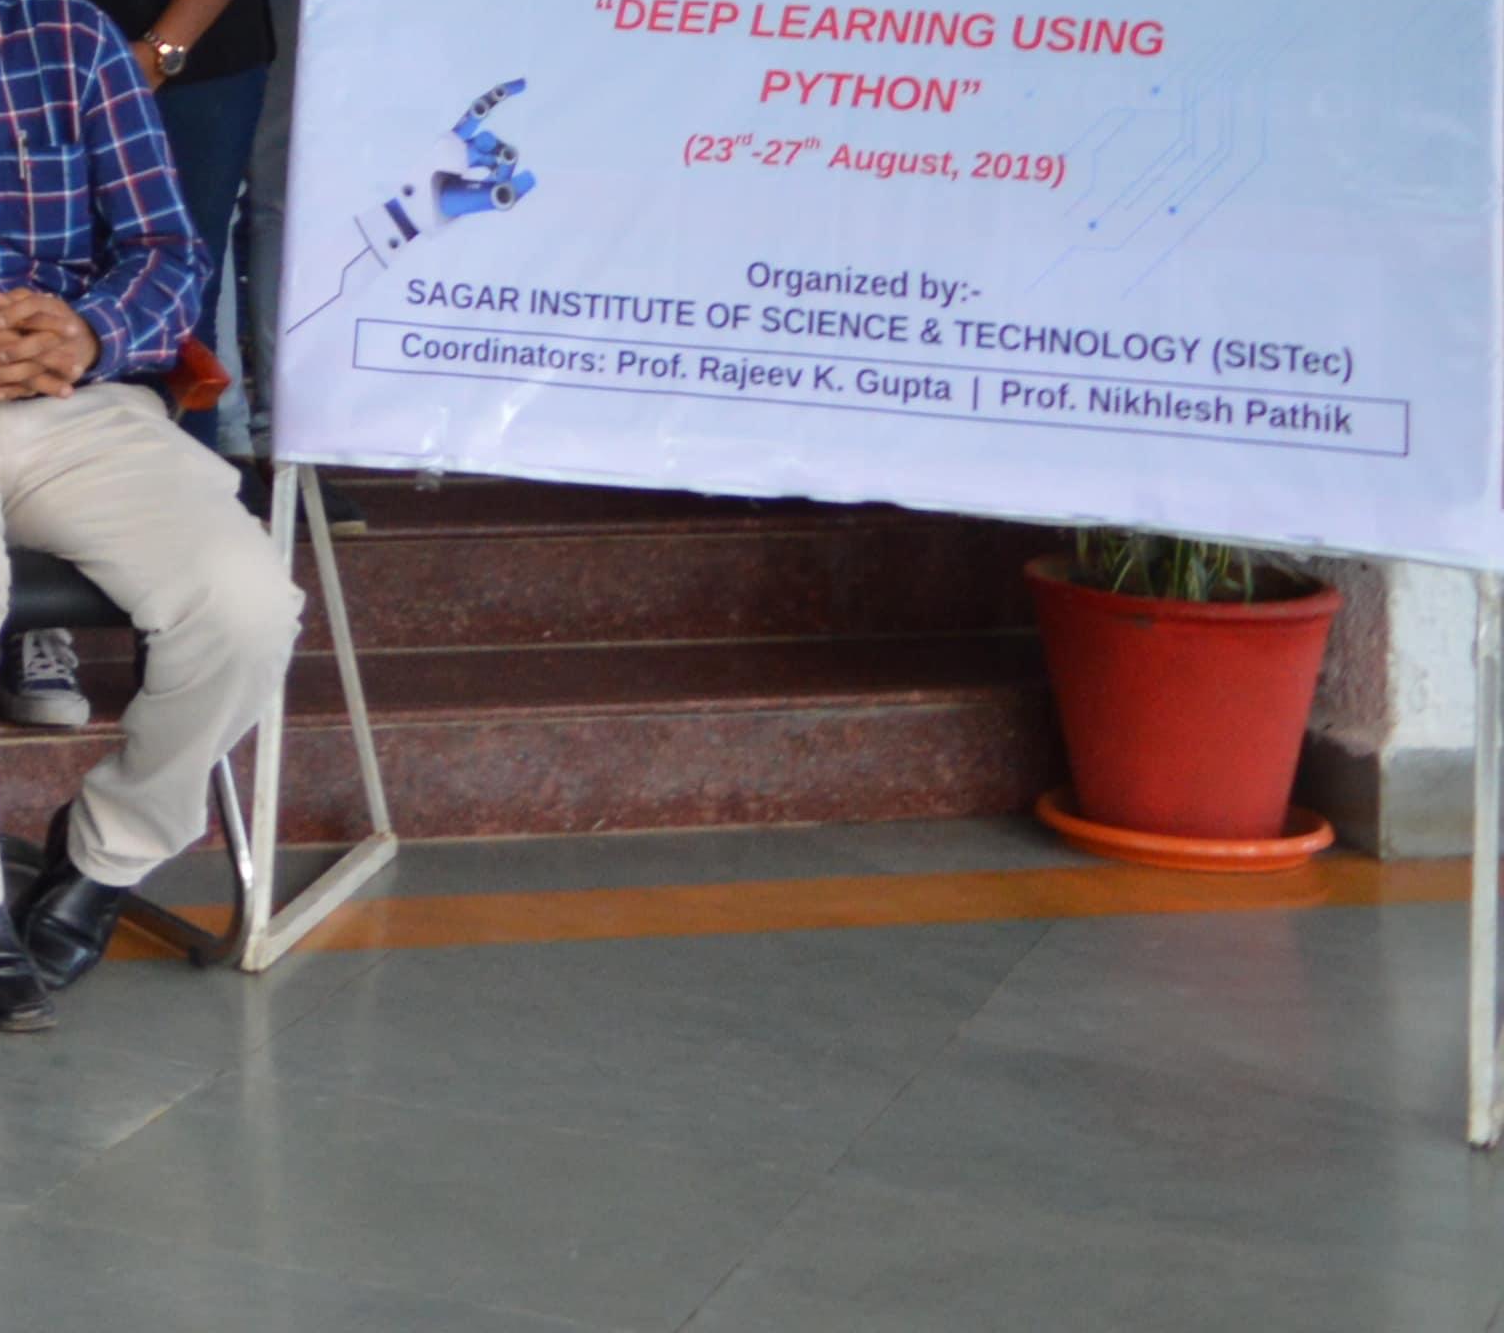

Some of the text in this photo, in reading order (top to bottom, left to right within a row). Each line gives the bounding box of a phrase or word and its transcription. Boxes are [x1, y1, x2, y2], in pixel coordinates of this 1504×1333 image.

[749, 3, 997, 49] LEARNING
[1010, 15, 1166, 57] USING
[759, 69, 982, 113] PYTHON”
[827, 142, 960, 181] August,
[970, 151, 1068, 189] 2019)
[745, 260, 981, 305] Organized by:-
[406, 278, 1355, 384] SAGAR INSTITUTE OF SCIENCE & TECHNOLOGY (SISTec)
[400, 333, 1354, 435] Coordinators: Prof. Rajeev K. Gupta Prof. Nikhlesh Pathik
